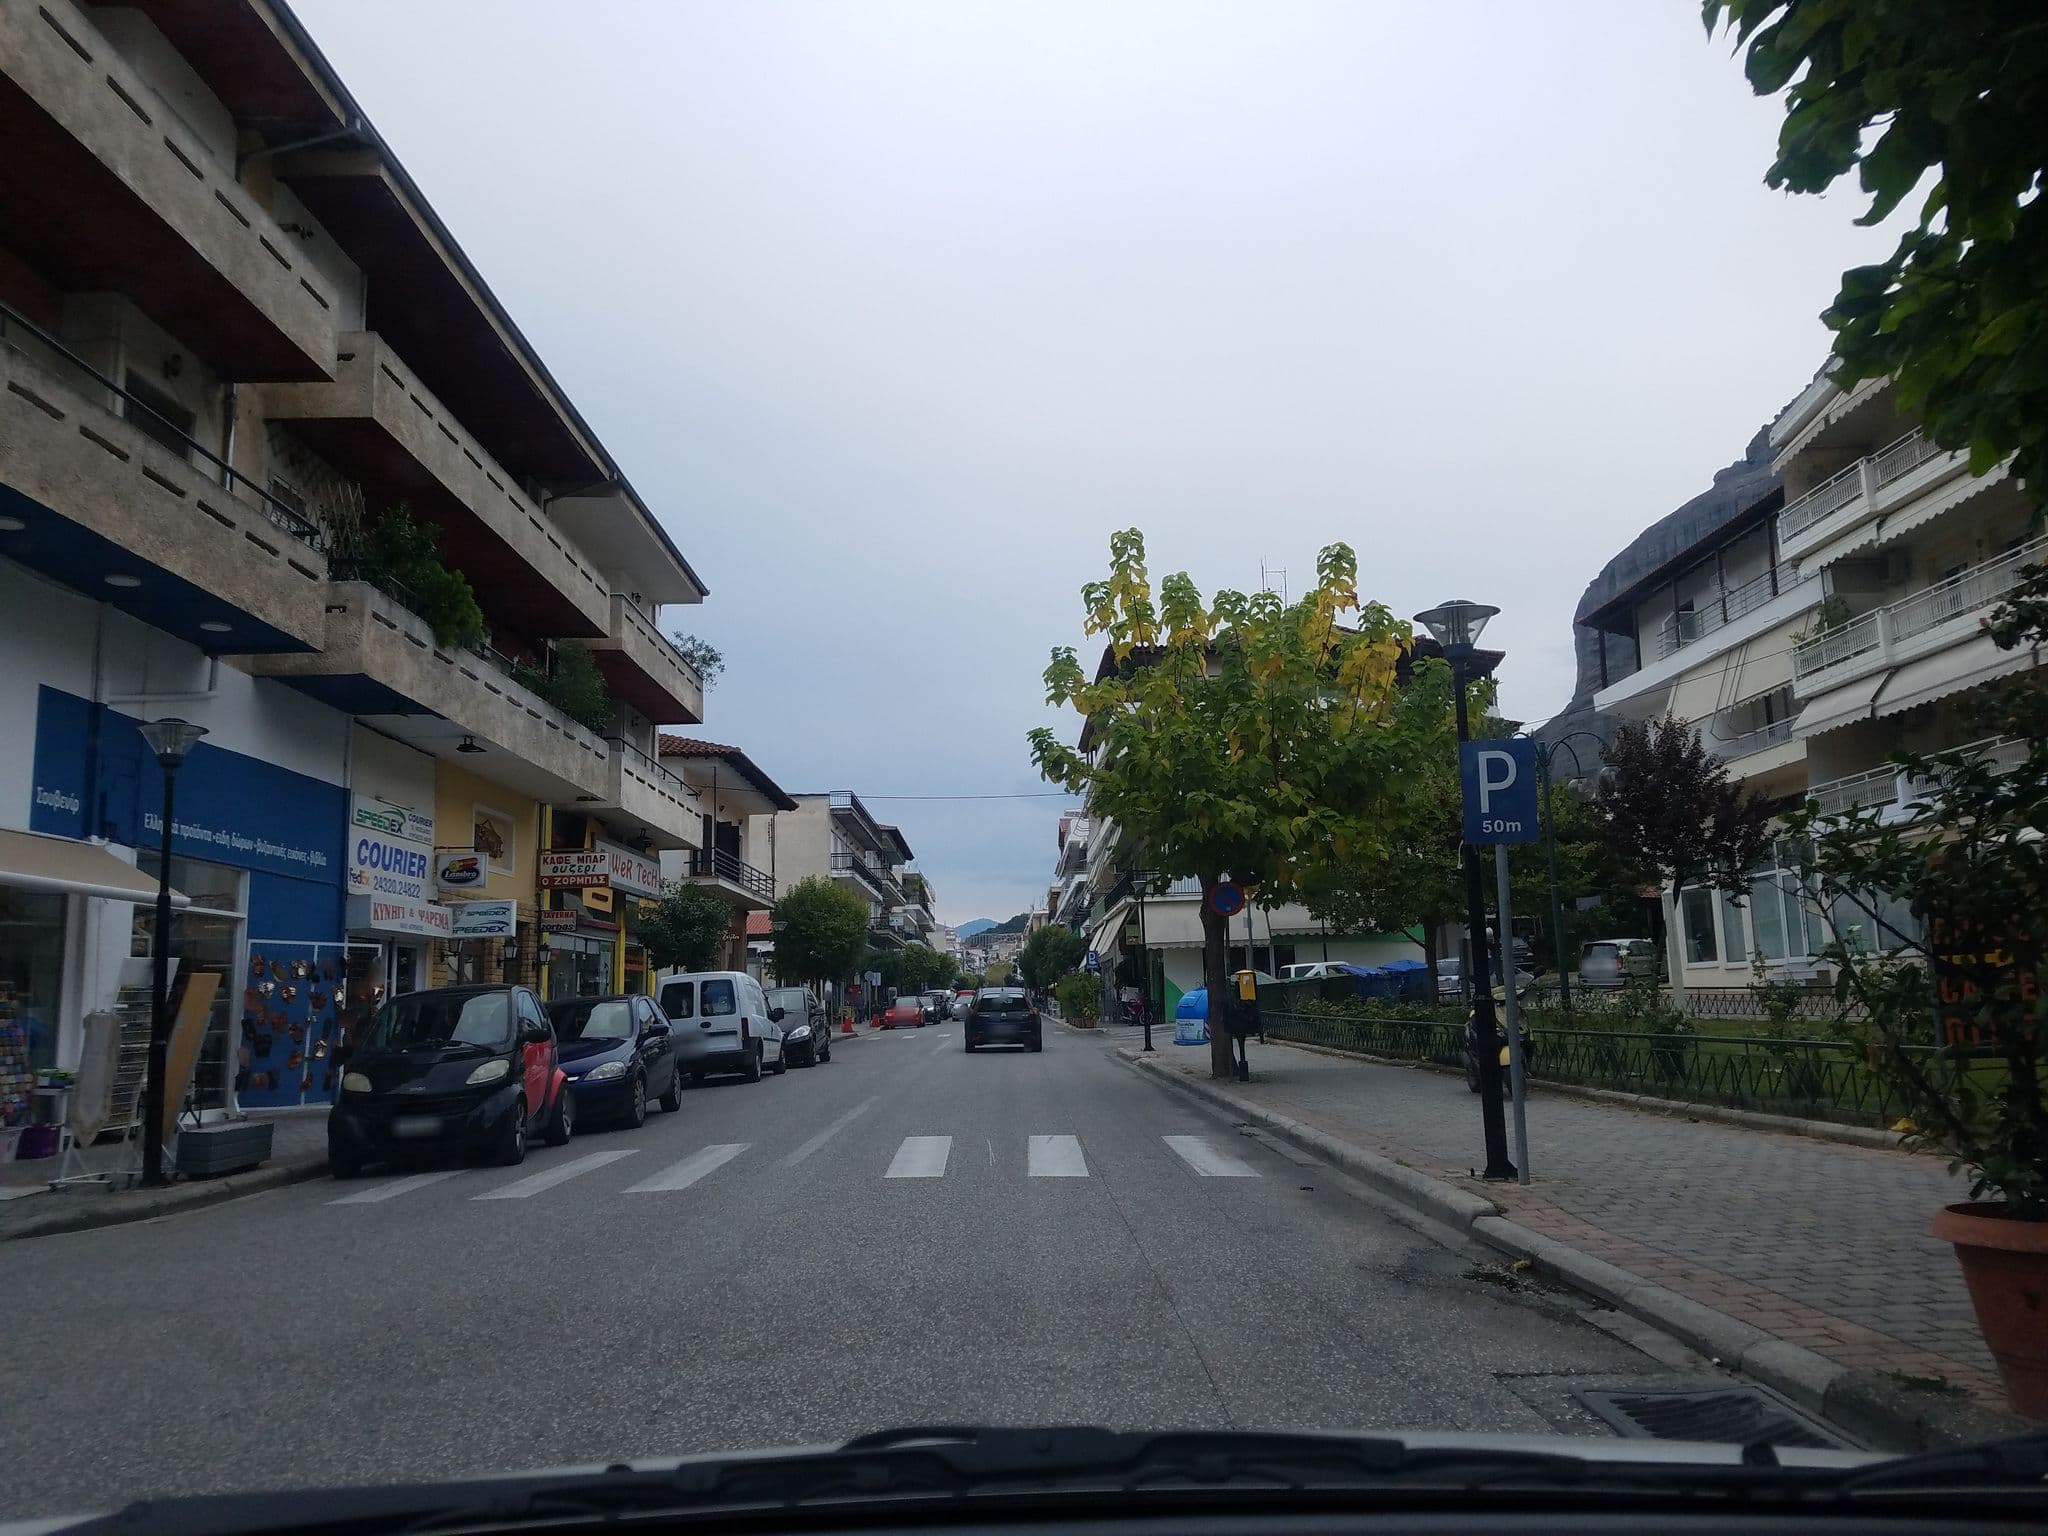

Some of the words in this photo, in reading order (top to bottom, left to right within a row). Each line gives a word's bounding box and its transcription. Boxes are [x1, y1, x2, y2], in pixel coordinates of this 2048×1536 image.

[1478, 751, 1517, 813] P
[36, 786, 80, 815] Σουβενίρ
[356, 809, 403, 834] SPEEDEX
[408, 813, 432, 828] COURIER
[1482, 820, 1521, 833] 50m
[357, 839, 427, 879] COURIER
[543, 855, 571, 865] ΚΑΦΕ
[577, 854, 606, 864] ΜΠΑΡ
[554, 875, 606, 885] ΖΟΡΜΠΑΣ
[373, 902, 404, 921] ΚΥΝΗΓΙ
[419, 910, 449, 930] ΨΑΡΕΜΑ
